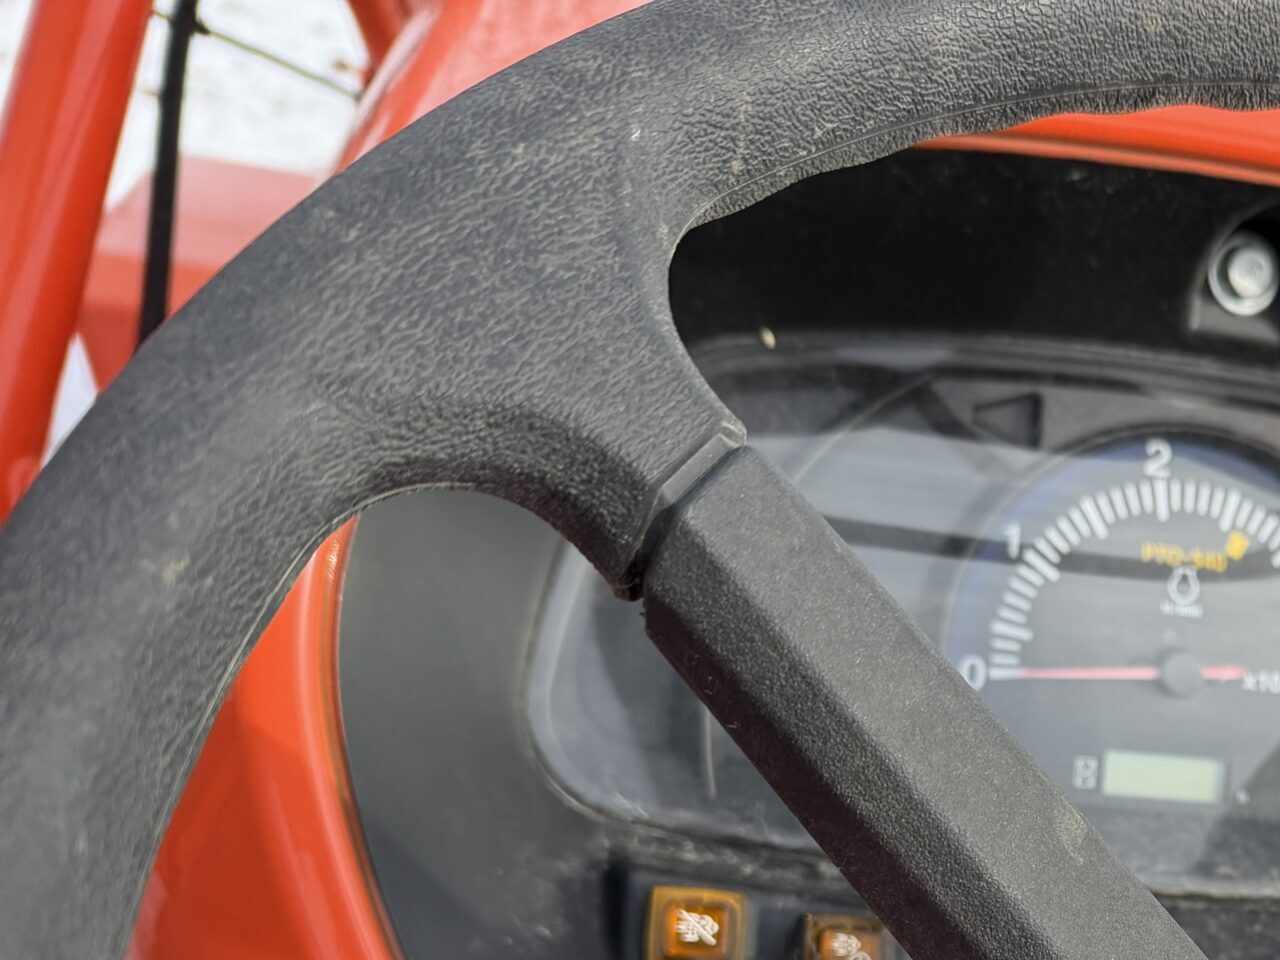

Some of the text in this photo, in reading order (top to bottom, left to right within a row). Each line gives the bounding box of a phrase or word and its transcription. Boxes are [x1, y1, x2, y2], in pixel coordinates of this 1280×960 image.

[1143, 438, 1173, 479] 2
[1006, 521, 1022, 560] 1
[961, 654, 988, 691] 0
